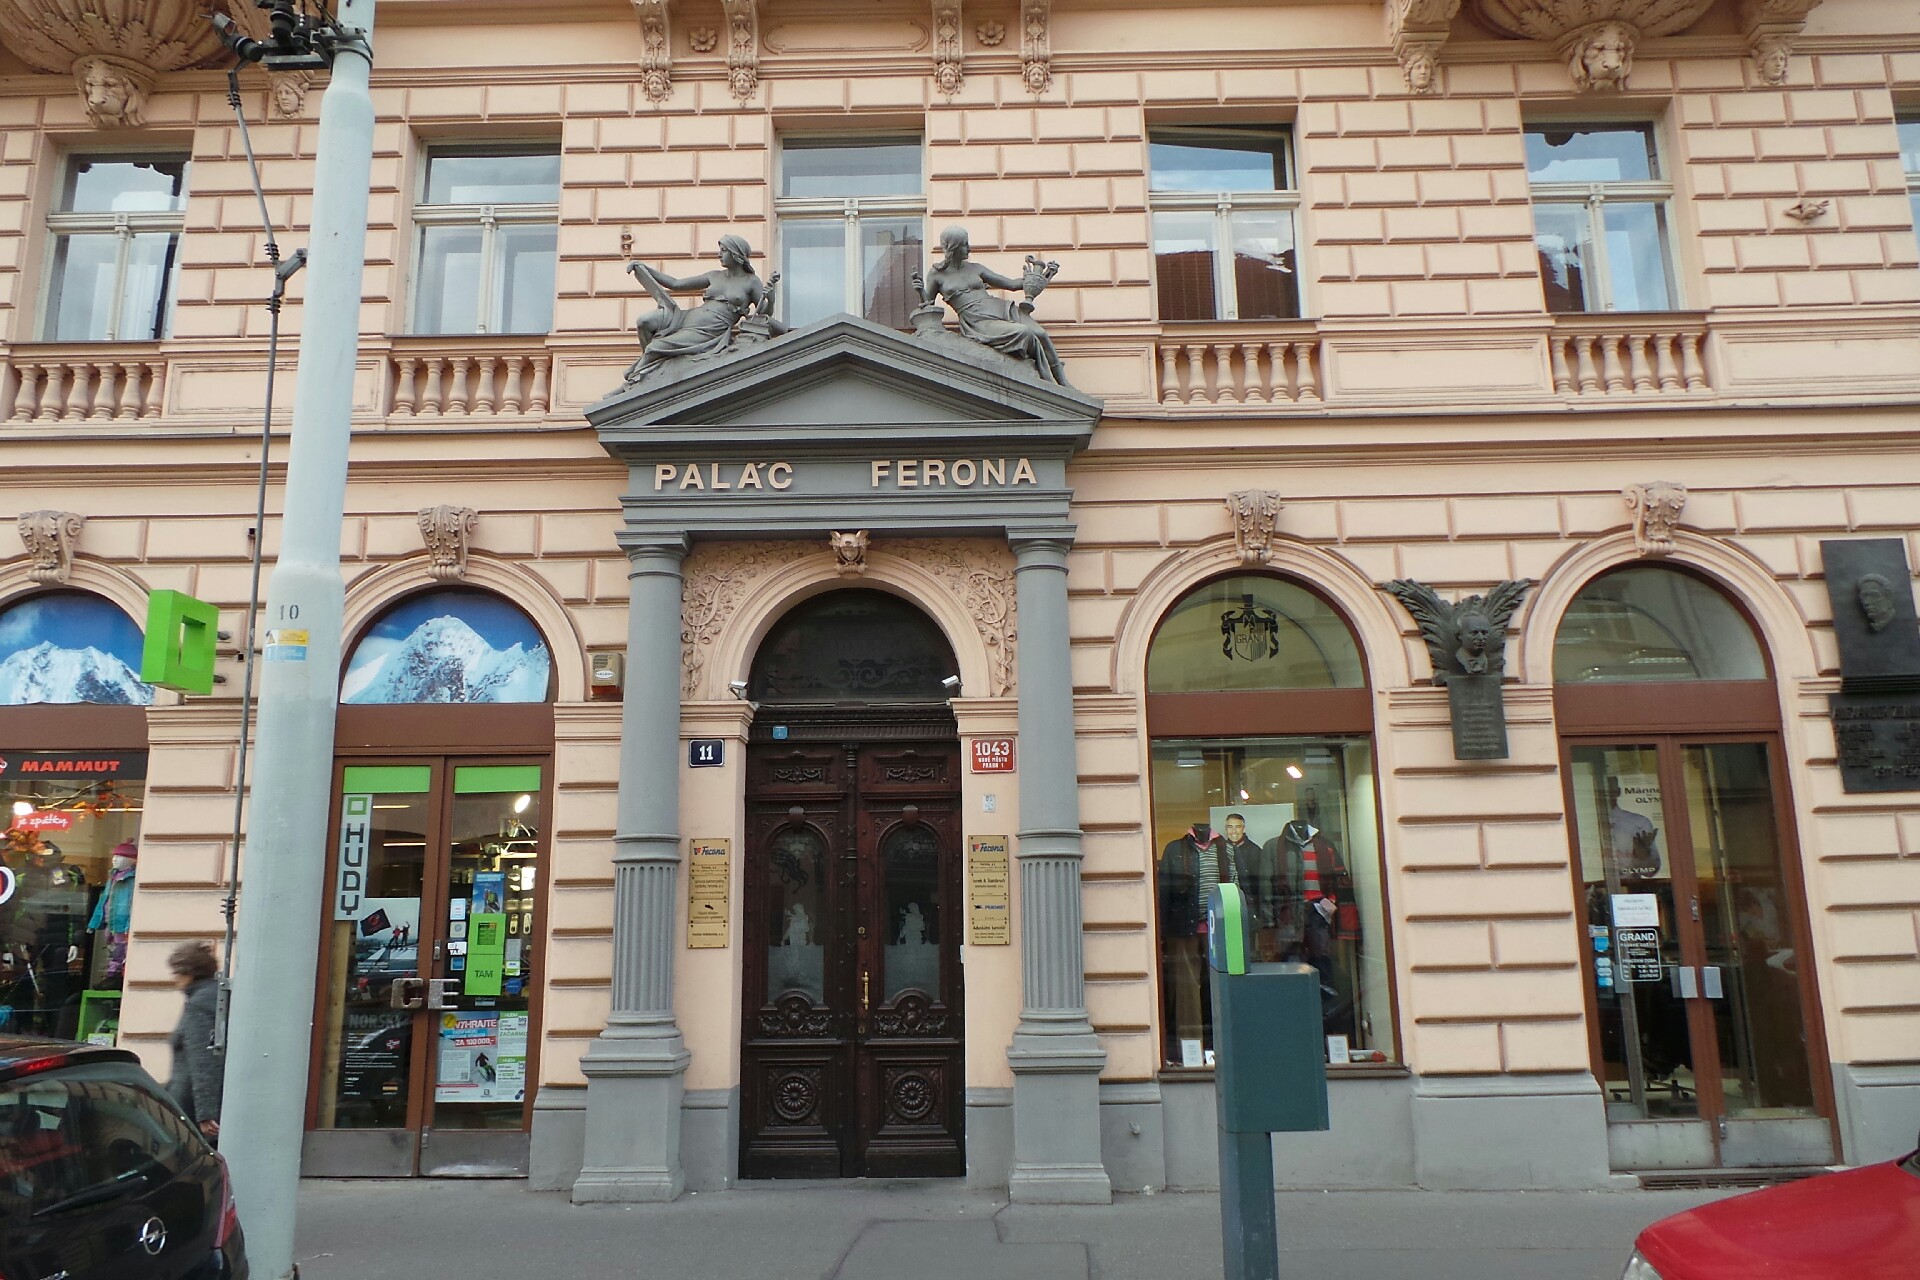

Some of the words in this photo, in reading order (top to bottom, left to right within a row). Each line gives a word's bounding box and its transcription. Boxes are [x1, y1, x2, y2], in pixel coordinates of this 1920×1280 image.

[654, 462, 794, 491] PALÁC
[870, 458, 1038, 488] FERONA
[280, 604, 299, 620] 10
[699, 744, 714, 760] 11
[975, 741, 1010, 756] 1043
[21, 761, 120, 772] MAMMUT
[340, 823, 365, 916] HUDY
[1619, 932, 1655, 942] GRAND
[475, 970, 494, 978] TAM
